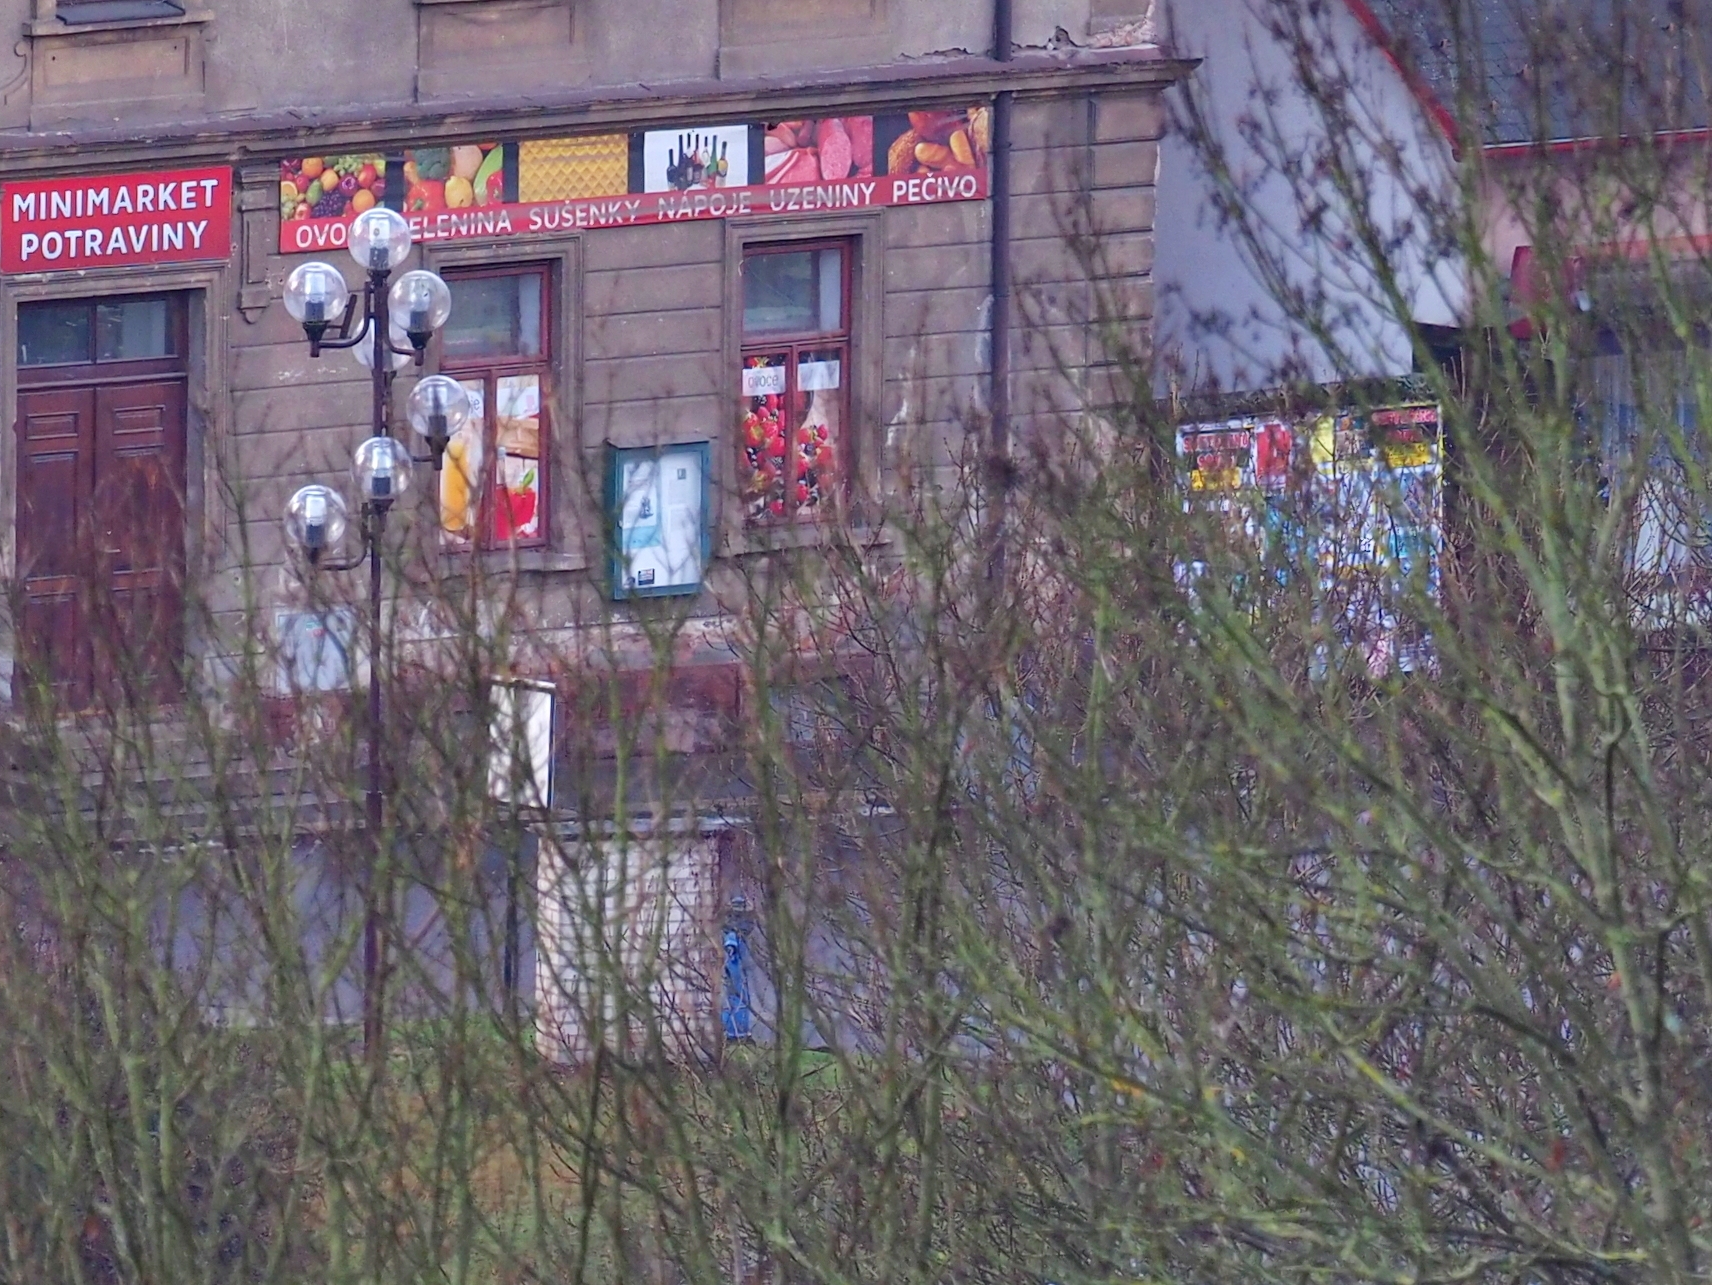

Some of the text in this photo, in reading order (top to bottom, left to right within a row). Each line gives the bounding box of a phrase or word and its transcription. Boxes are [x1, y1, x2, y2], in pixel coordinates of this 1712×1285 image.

[12, 179, 218, 222] MINIMARKET
[296, 172, 977, 248] OVO ELENINA SUŠENKY NÁPOJE UZENINY PEČIVO
[21, 220, 208, 261] POTRAVINY
